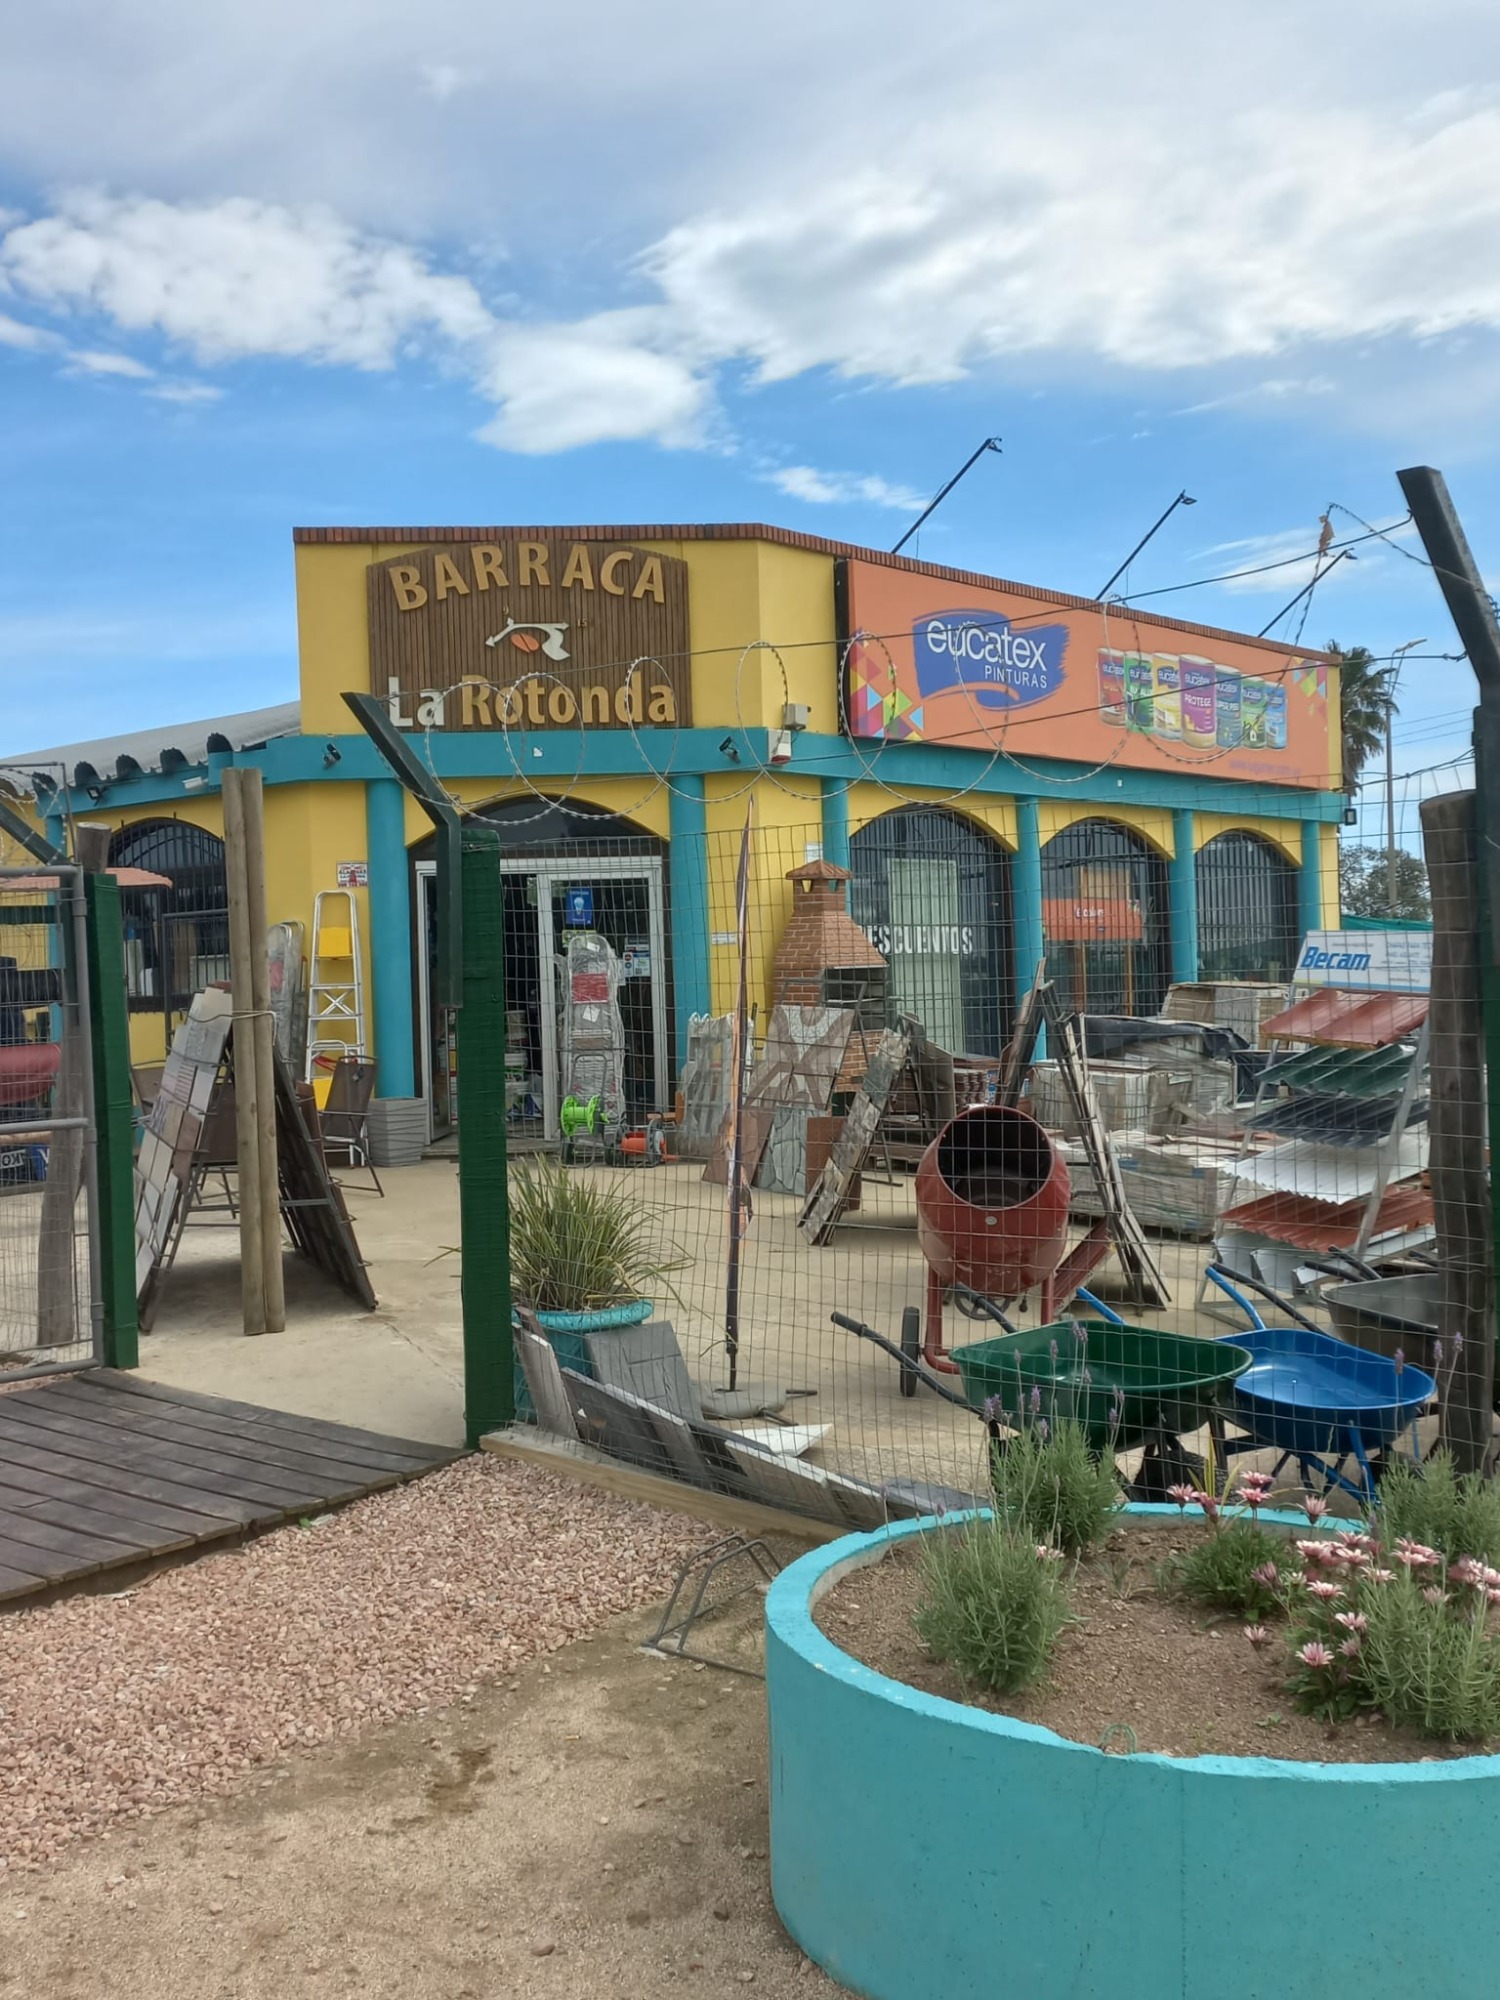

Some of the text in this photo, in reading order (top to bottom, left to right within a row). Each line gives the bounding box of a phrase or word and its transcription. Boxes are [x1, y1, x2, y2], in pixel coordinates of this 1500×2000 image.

[388, 541, 665, 611] BARRACA
[926, 620, 1048, 672] eucatex
[984, 665, 1048, 689] PINTURAS
[388, 671, 677, 728] La Rotonda
[858, 925, 973, 955] ESCUENTOS
[1301, 946, 1371, 971] Becam
